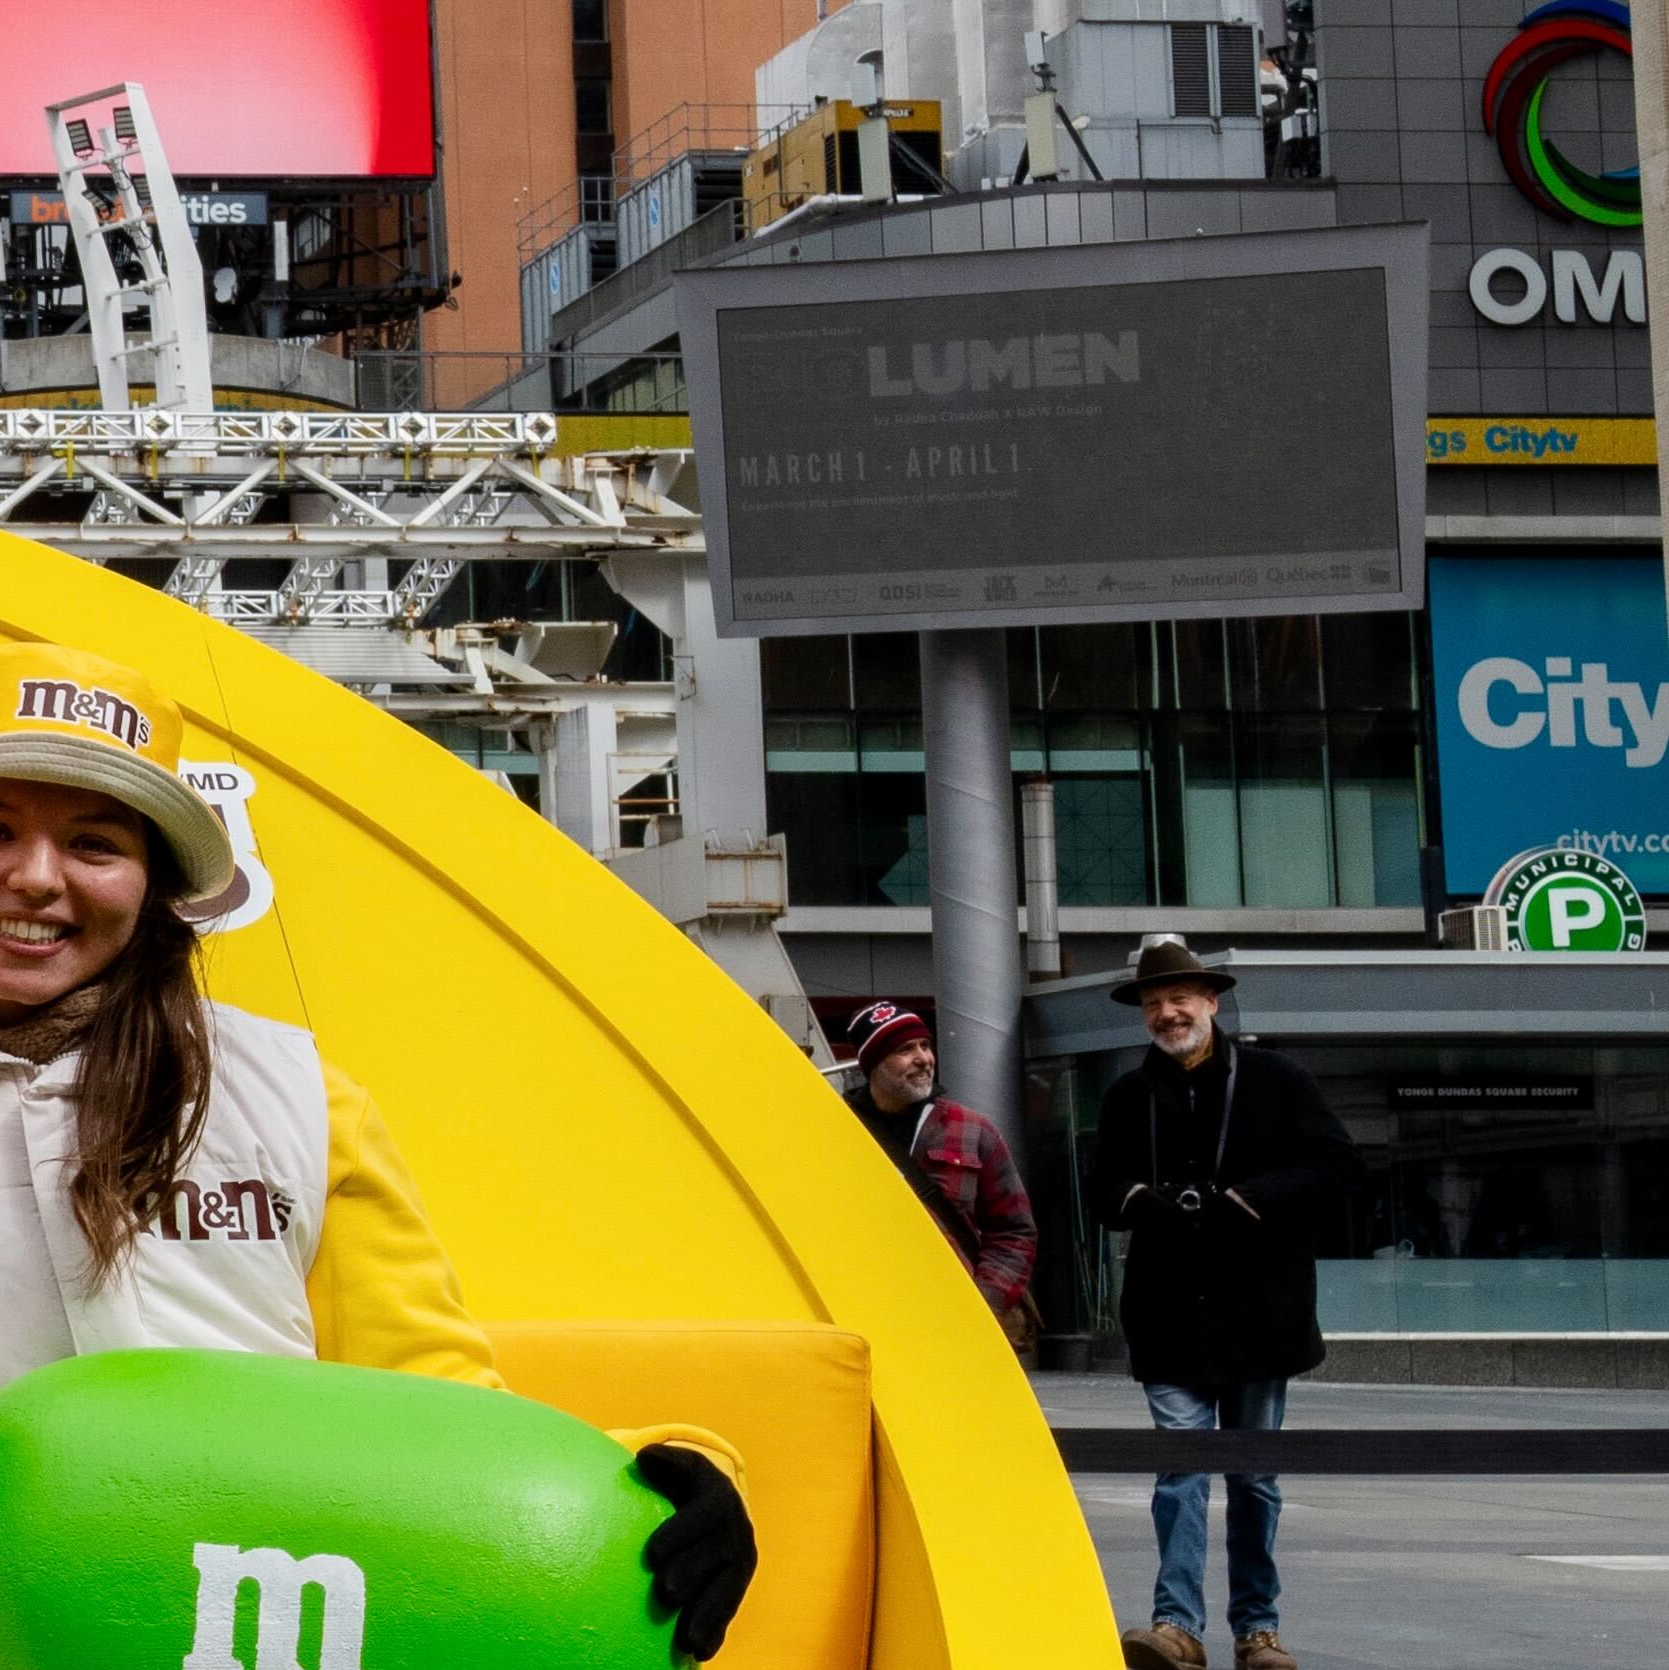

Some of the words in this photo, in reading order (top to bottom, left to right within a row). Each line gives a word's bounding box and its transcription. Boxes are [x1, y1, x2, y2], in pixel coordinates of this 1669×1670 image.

[1484, 425, 1579, 459] Citytv
[740, 452, 843, 488] MARCH
[856, 450, 867, 482] 1
[906, 443, 998, 480] APRIL
[1505, 853, 1635, 913] MUNICIPAL
[1547, 887, 1607, 948] P
[1397, 1087, 1435, 1097] YONGE
[1437, 1087, 1482, 1097] DUNDAS
[1485, 1087, 1528, 1097] SQUARE
[1530, 1087, 1580, 1097] SECURITY
